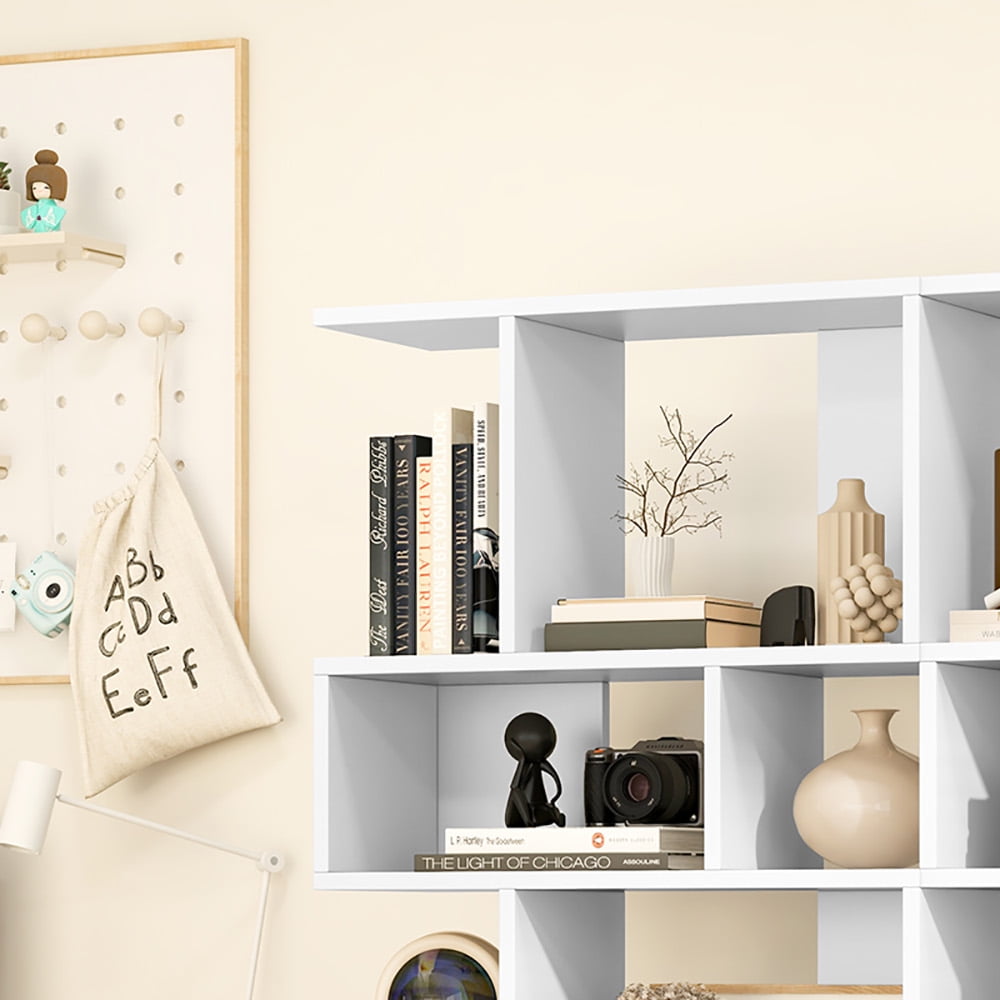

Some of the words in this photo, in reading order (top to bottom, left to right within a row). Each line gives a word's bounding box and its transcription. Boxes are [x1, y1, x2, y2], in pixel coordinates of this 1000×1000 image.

[396, 459, 409, 510] YEARS
[419, 463, 431, 535] RALPH
[456, 447, 468, 504] VANITY
[370, 491, 388, 550] Richard
[456, 510, 468, 545] FAIR
[396, 549, 409, 586] FAIR
[419, 545, 431, 632] LAUREN
[396, 594, 409, 653] VANITY
[456, 583, 468, 632] YEARS
[370, 624, 388, 652] The
[422, 857, 454, 870] THE
[457, 857, 504, 869] LIGHT
[507, 857, 529, 869] OF
[532, 856, 611, 869] CHICAGO
